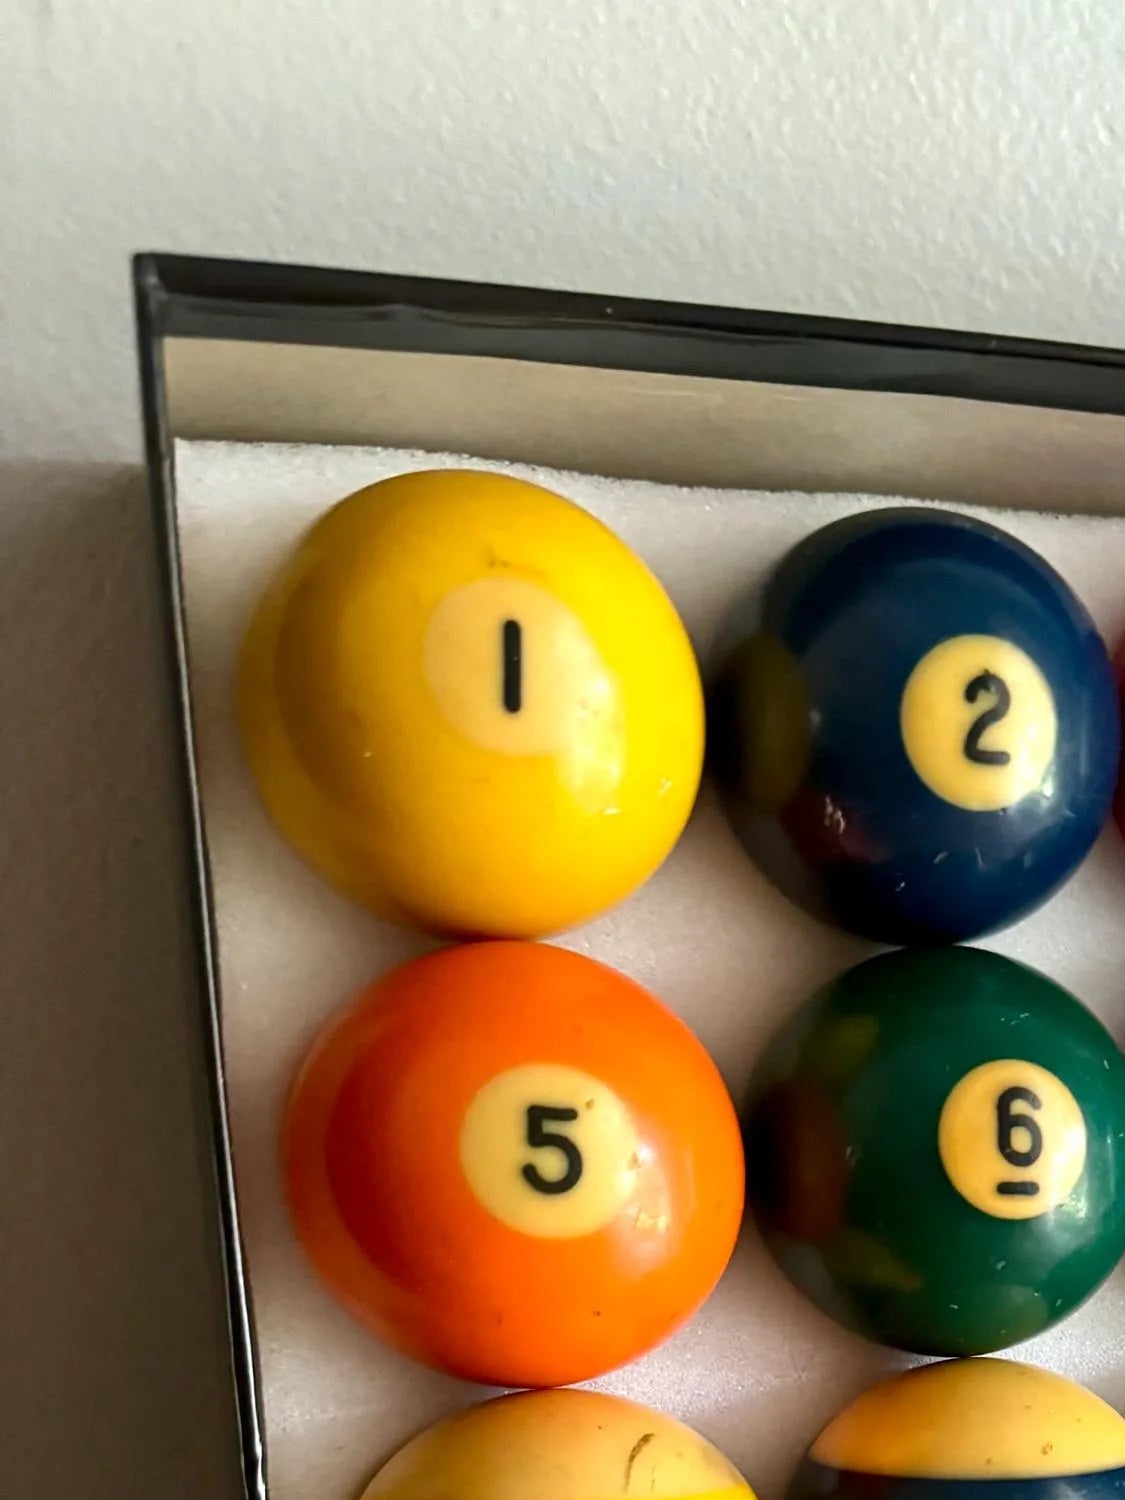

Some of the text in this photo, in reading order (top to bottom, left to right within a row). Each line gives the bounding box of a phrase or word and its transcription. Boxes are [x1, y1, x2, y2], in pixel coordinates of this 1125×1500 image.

[500, 618, 523, 715] 1
[962, 668, 1012, 767] 2
[519, 1102, 584, 1197] 5
[994, 1084, 1043, 1169] 6
